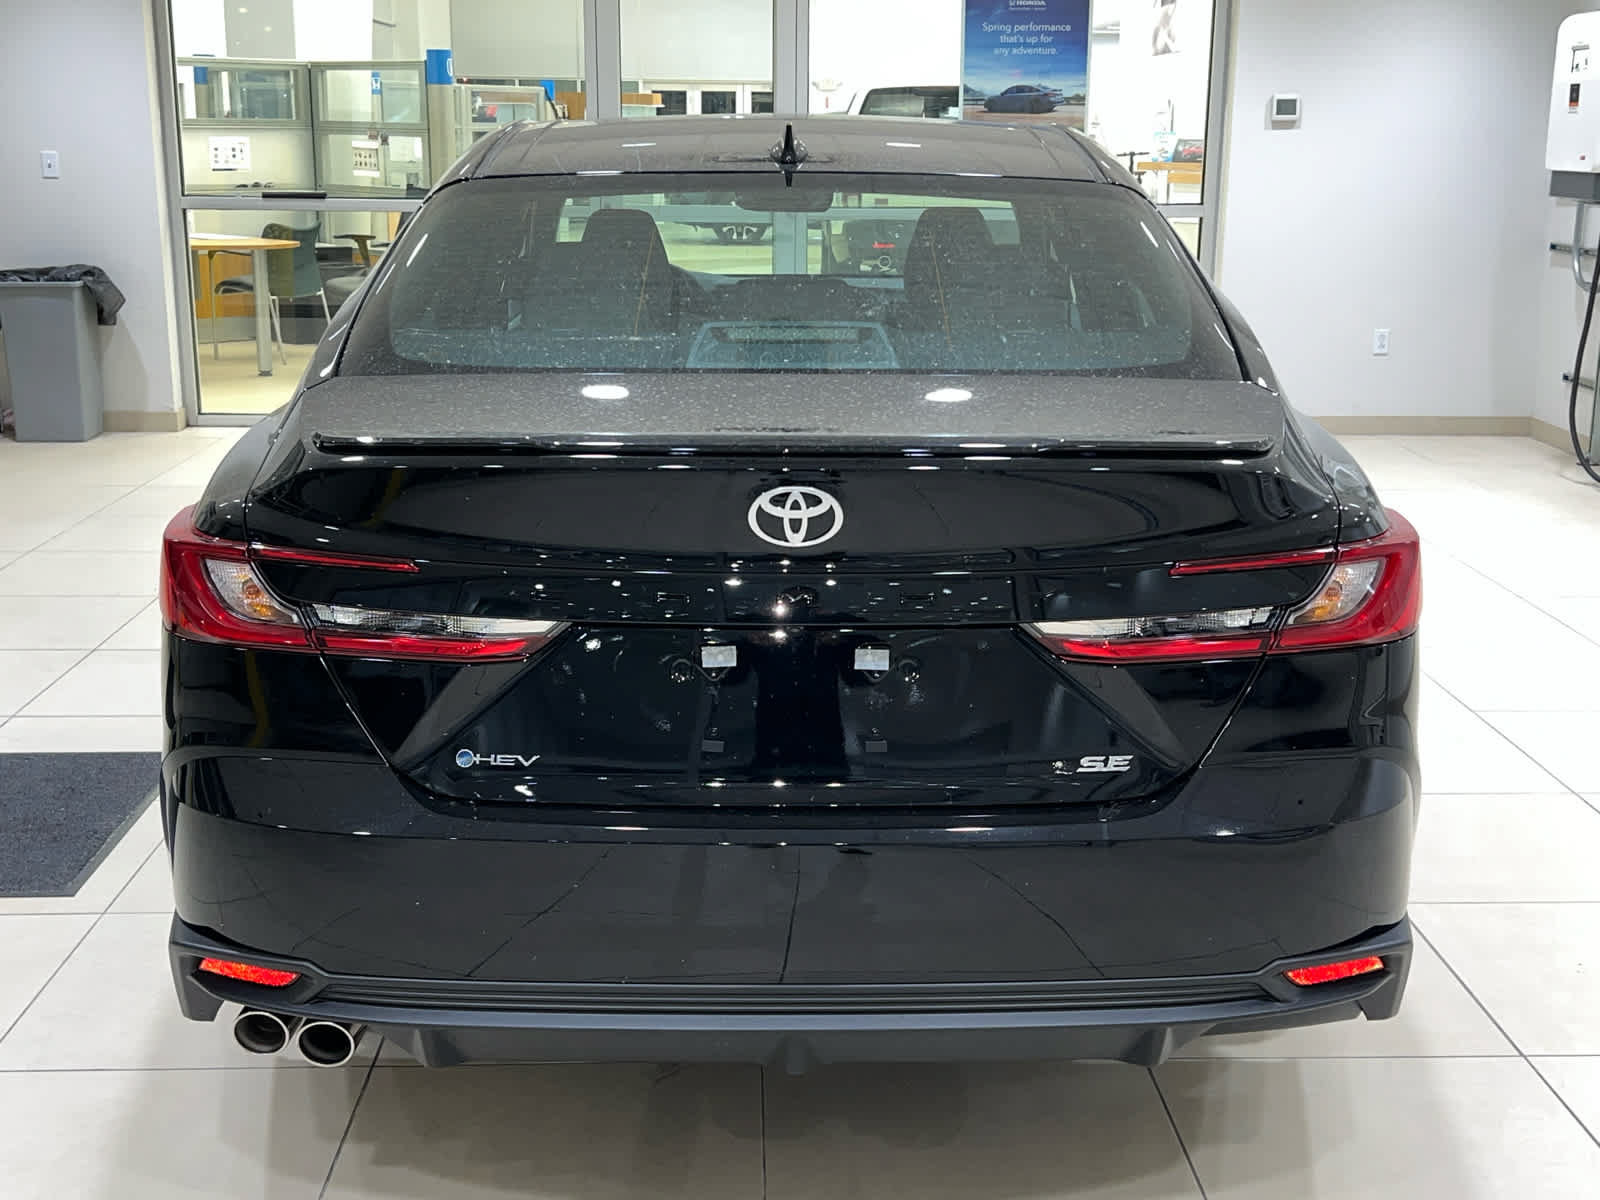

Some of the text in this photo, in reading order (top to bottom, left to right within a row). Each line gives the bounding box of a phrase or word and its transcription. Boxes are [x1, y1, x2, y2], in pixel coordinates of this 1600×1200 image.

[982, 21, 1072, 33] Spring performance
[1000, 34, 1054, 45] that's up for
[993, 47, 1009, 56] any
[475, 753, 541, 767] HEV
[1076, 755, 1134, 773] SE
